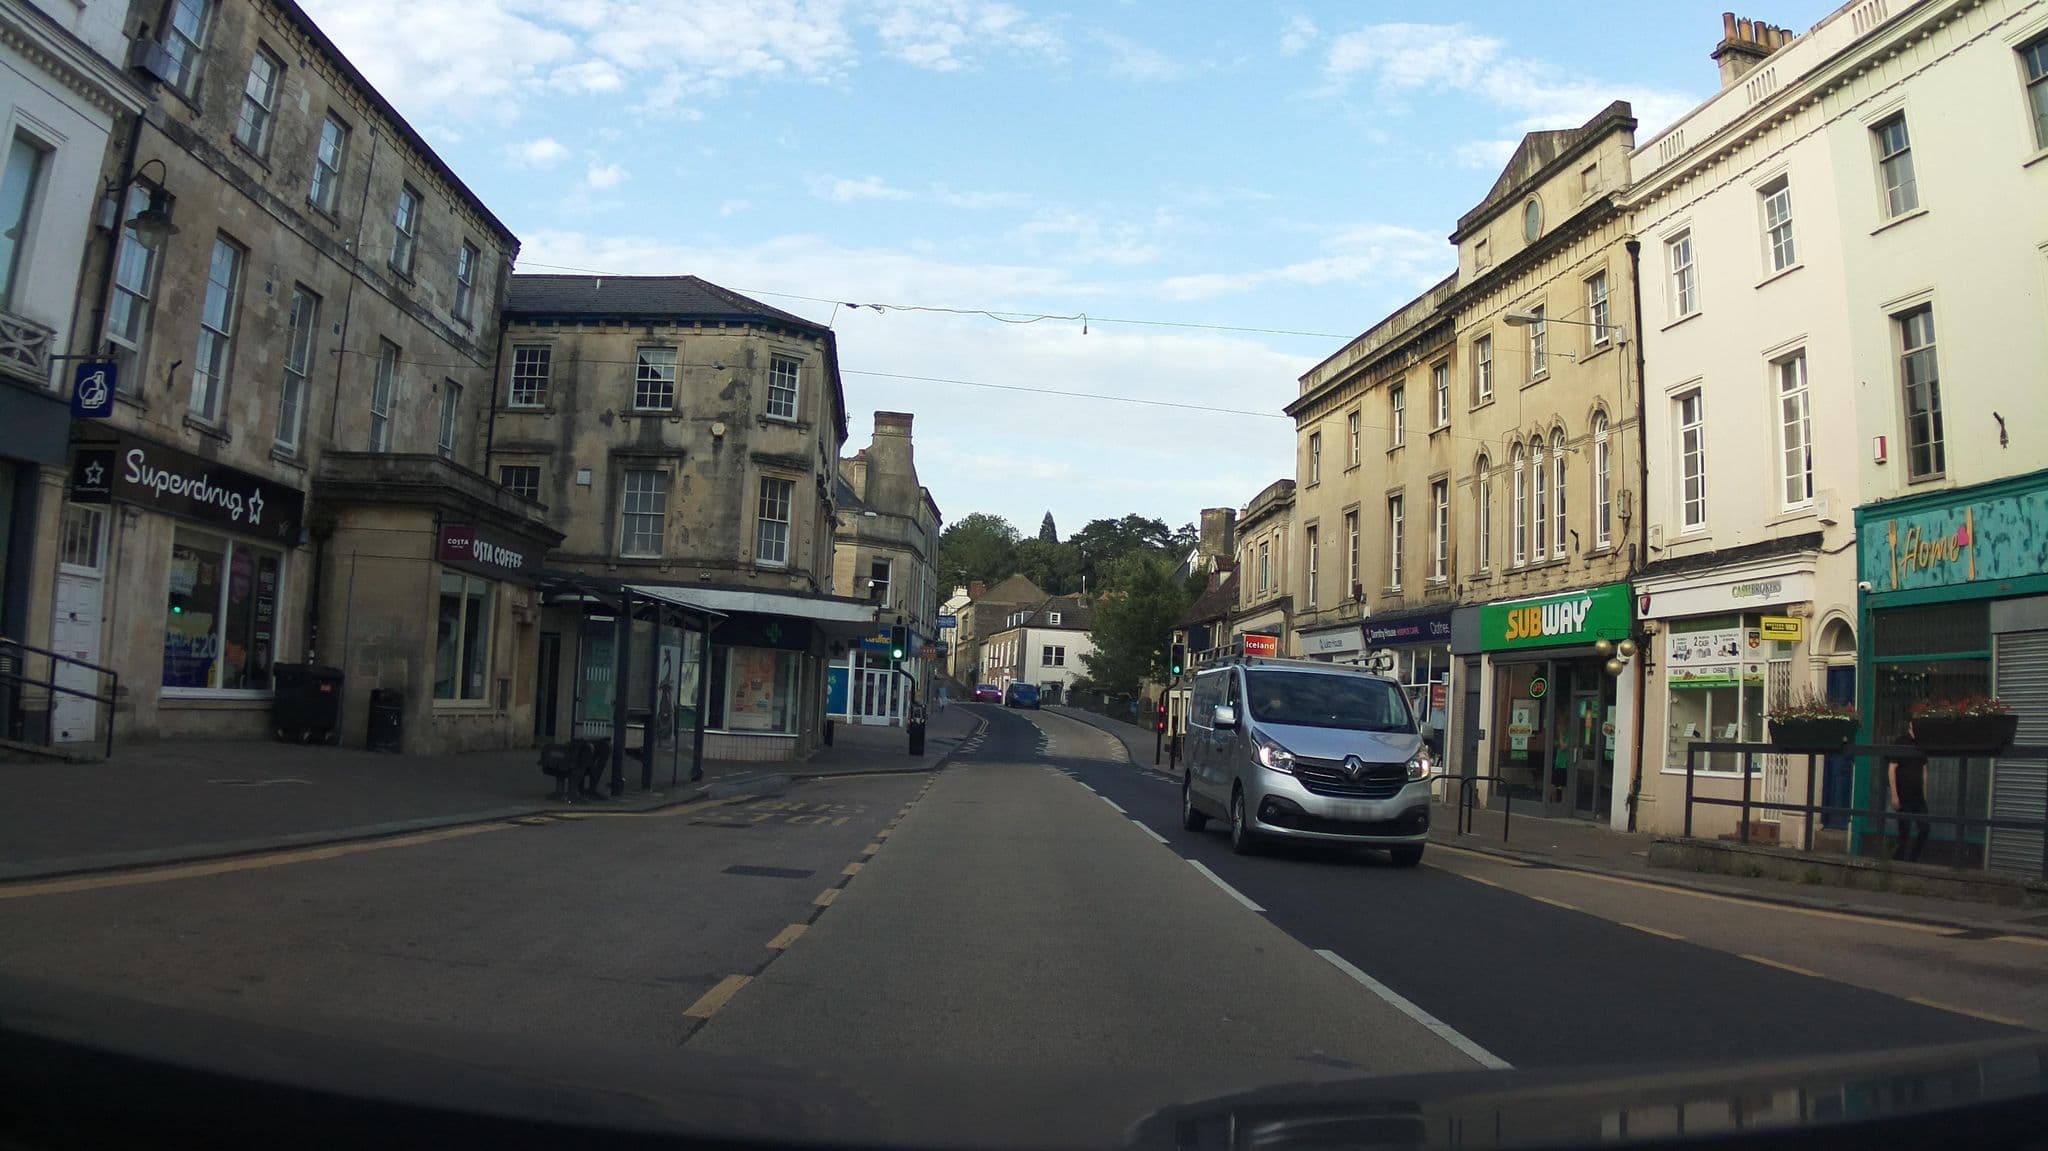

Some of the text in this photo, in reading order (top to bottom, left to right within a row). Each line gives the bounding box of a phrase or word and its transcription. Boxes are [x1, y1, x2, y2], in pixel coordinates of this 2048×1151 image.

[125, 449, 244, 520] Superdrug
[447, 538, 470, 546] COSTA
[473, 539, 523, 569] OSTA COFFEE
[1900, 526, 1960, 580] Home
[1506, 596, 1592, 641] SUBWAY
[1246, 641, 1274, 650] Iceland
[1694, 636, 1698, 646] 2
[1713, 635, 1718, 645] 3
